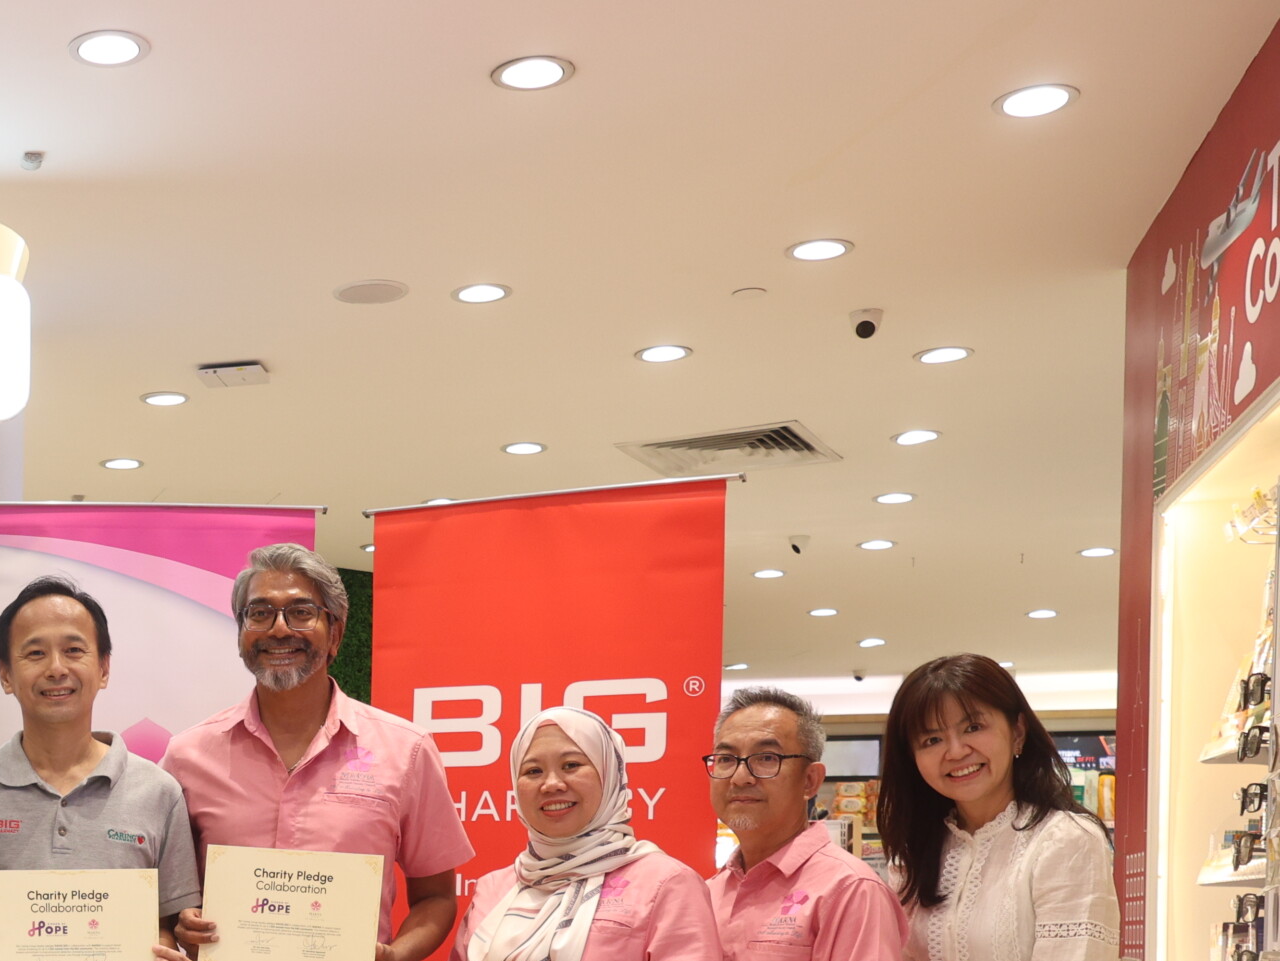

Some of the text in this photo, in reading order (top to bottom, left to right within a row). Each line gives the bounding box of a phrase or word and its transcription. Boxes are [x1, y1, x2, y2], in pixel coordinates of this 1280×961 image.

[254, 868, 334, 885] Charity Pledge
[256, 880, 327, 895] Collaboration
[27, 889, 109, 903] Charity Pledge
[30, 903, 104, 914] Collaboration
